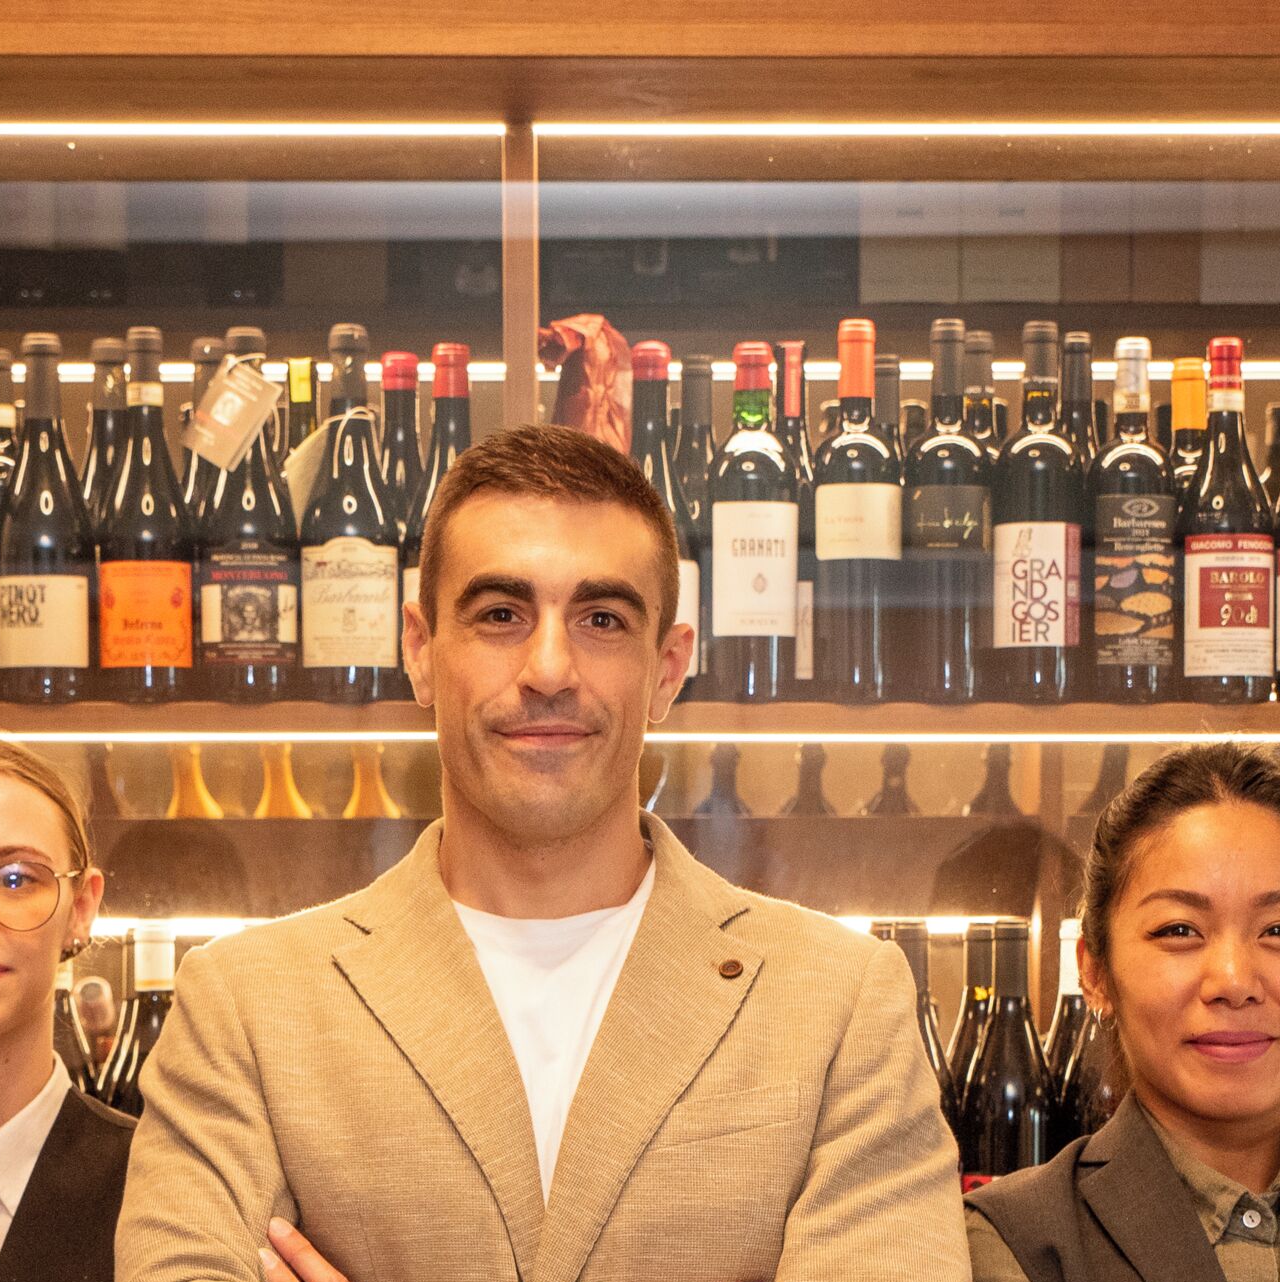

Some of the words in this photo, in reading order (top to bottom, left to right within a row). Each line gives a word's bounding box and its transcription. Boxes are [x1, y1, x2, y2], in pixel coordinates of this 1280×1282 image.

[1190, 540, 1234, 551] GIACOMO
[1011, 558, 1062, 580] GRA
[1209, 571, 1265, 583] BAROLO
[1012, 580, 1048, 601] ND
[1011, 600, 1060, 622] GOS
[1012, 621, 1050, 642] IER
